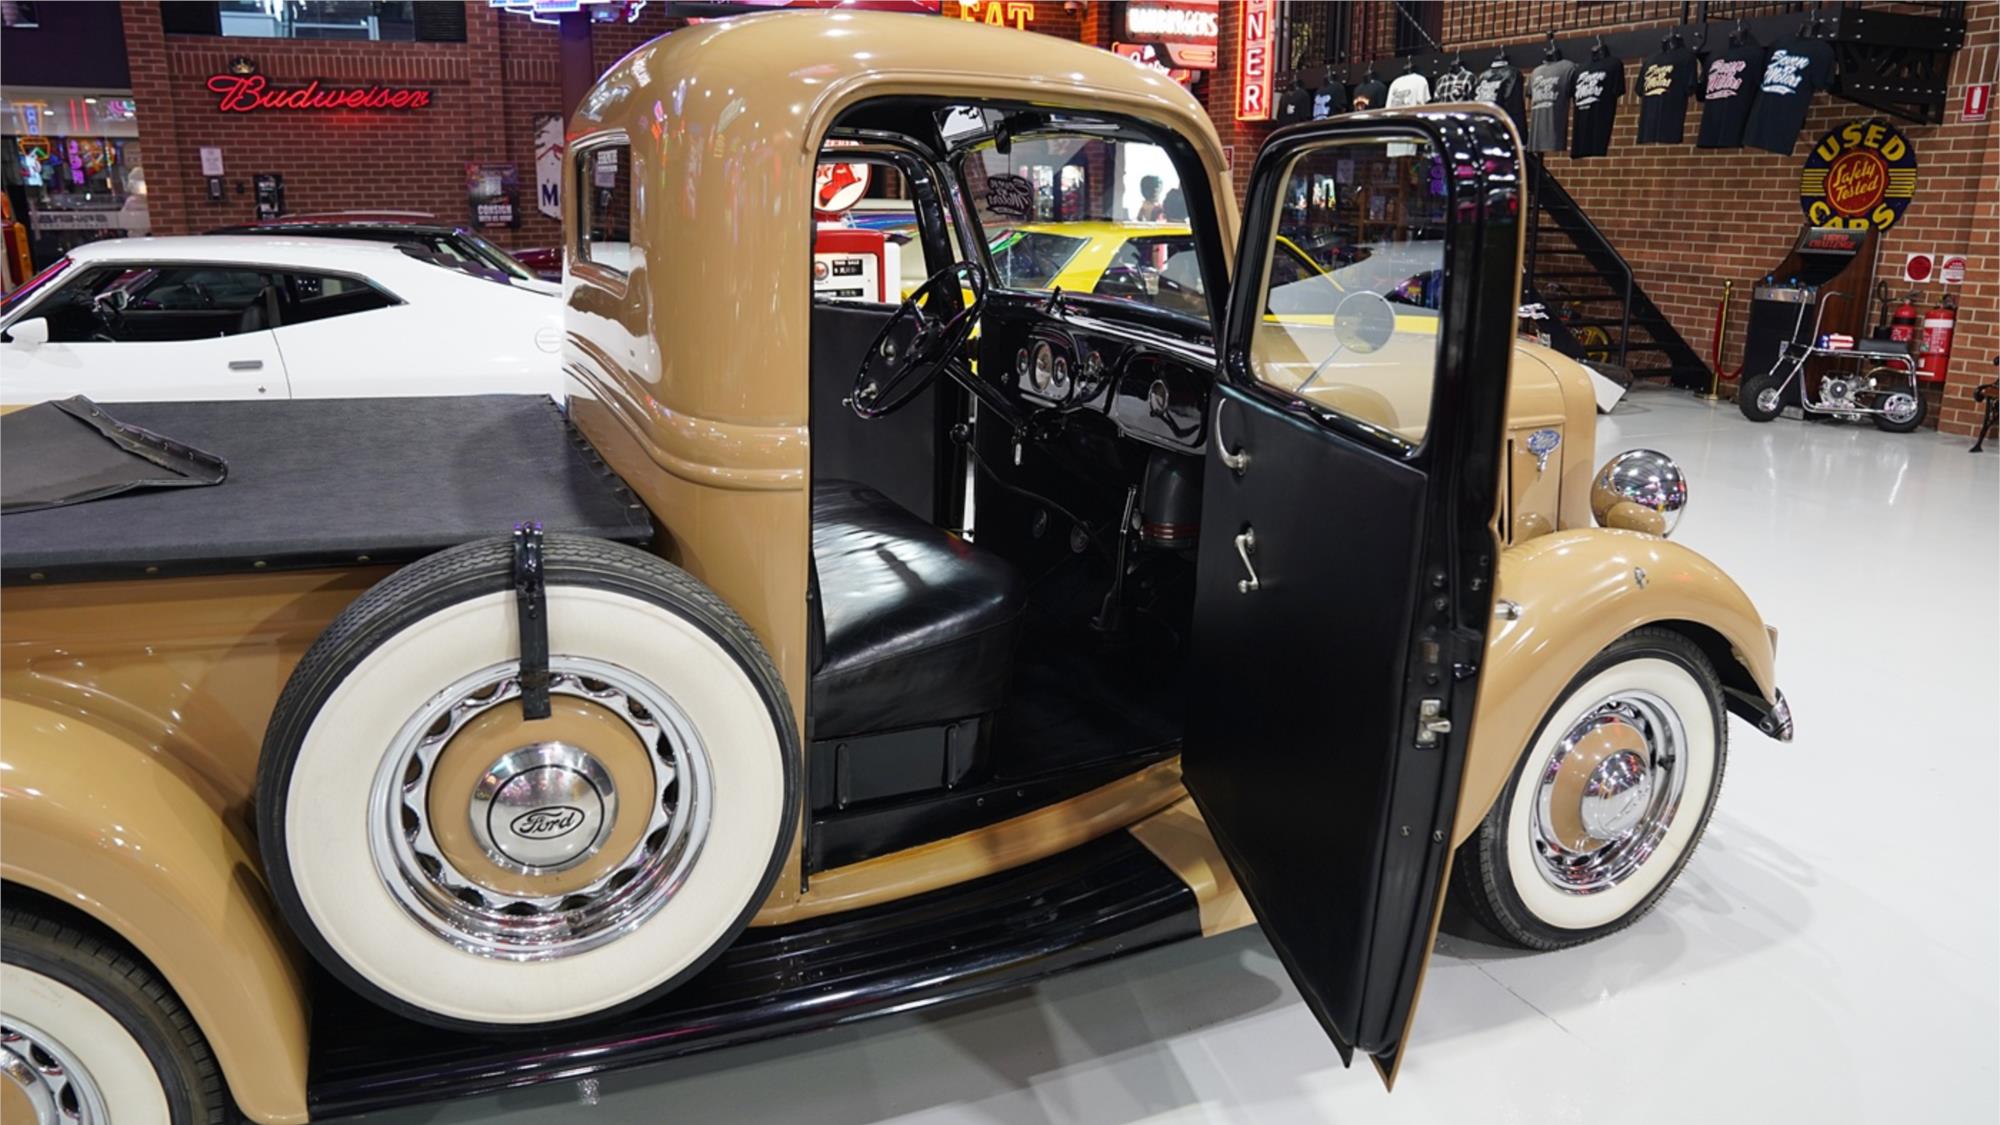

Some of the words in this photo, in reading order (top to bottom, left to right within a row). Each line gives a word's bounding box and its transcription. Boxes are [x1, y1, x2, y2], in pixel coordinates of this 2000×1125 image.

[1243, 0, 1265, 112] NER
[207, 75, 430, 112] Budweiser
[1816, 123, 1907, 162] USED
[1831, 160, 1877, 188] Safety
[1834, 174, 1880, 202] Tested
[518, 811, 576, 834] Ford
